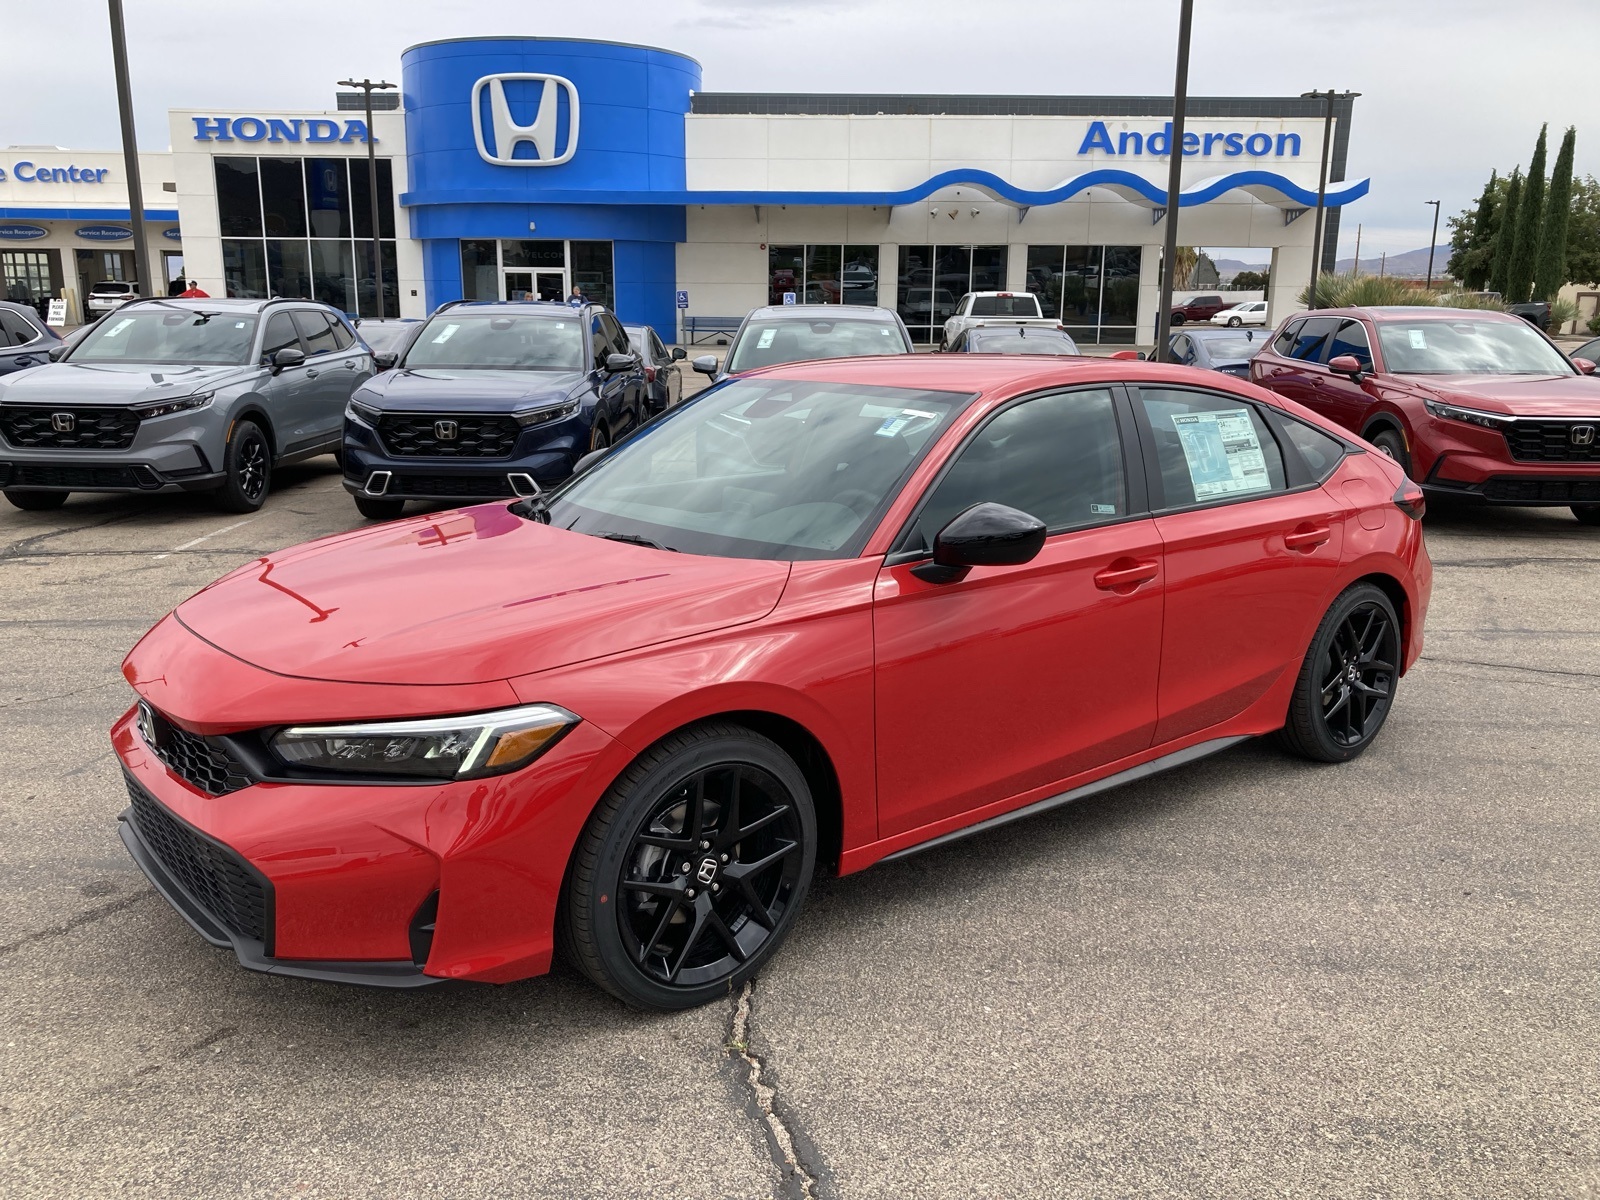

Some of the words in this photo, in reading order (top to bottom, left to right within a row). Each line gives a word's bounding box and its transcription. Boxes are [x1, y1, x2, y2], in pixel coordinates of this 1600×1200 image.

[192, 117, 379, 143] HONDA
[1077, 121, 1301, 157] Anderson
[13, 161, 108, 183] Center
